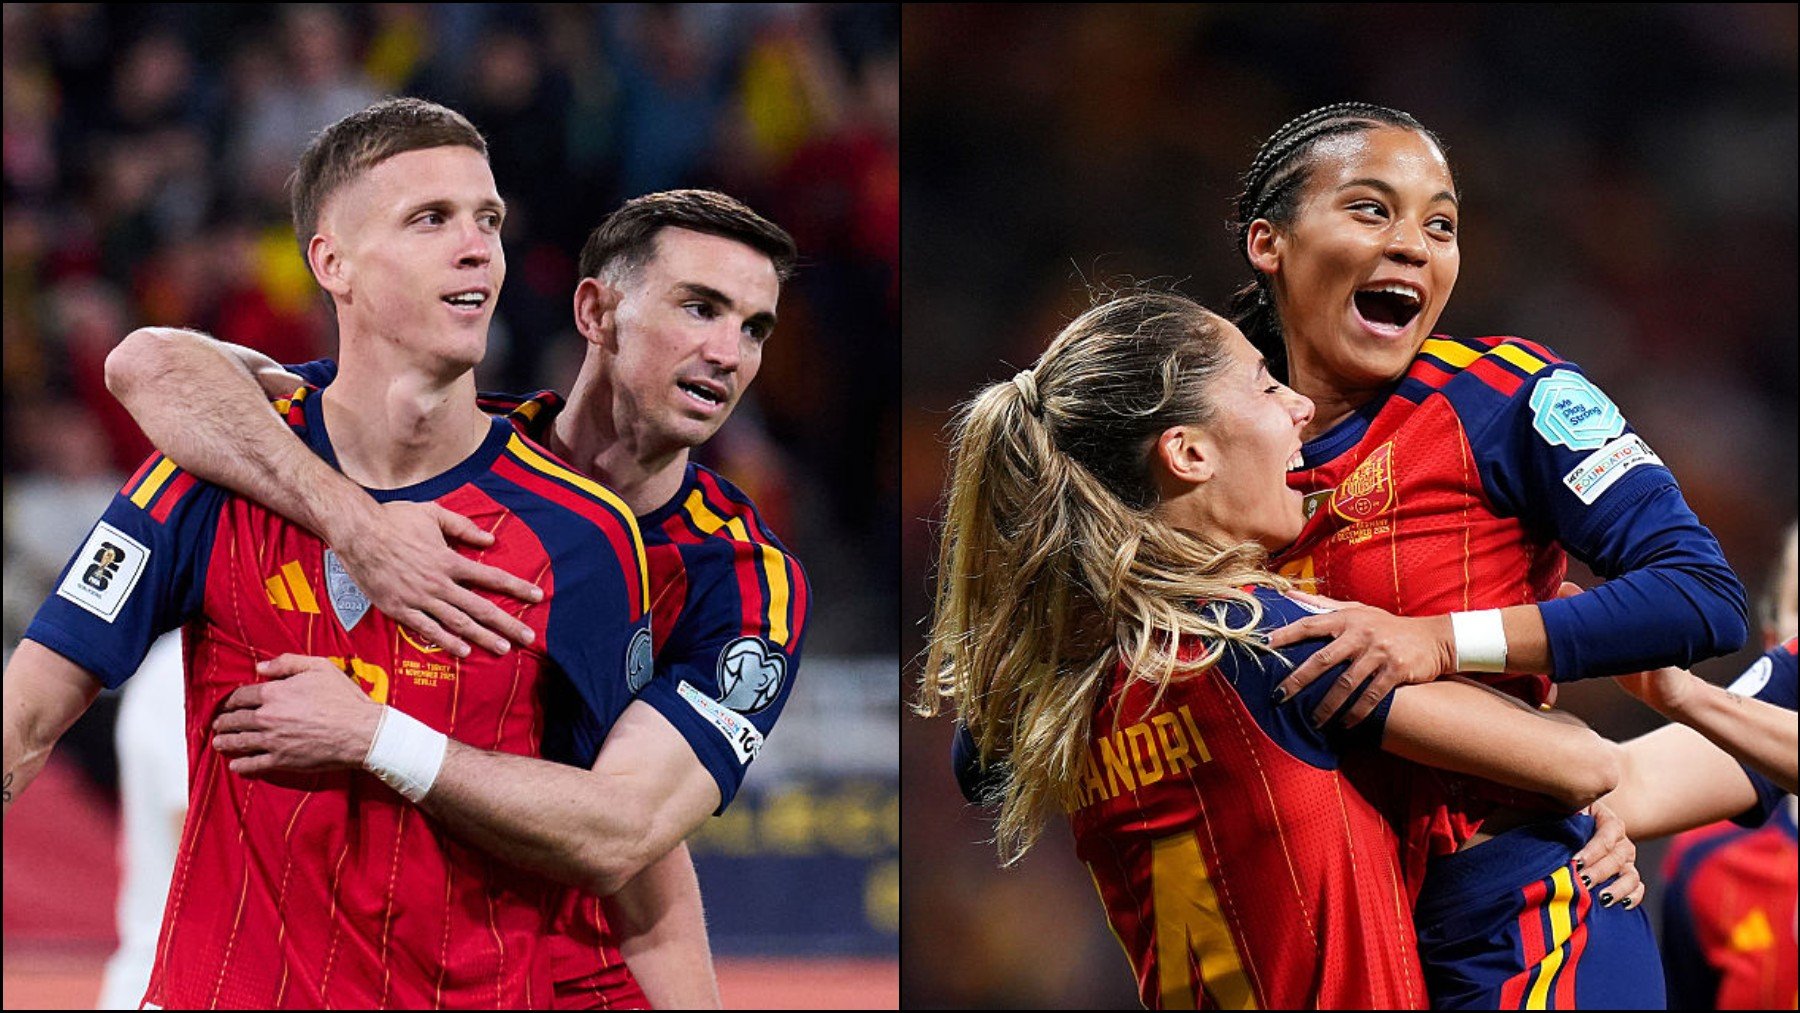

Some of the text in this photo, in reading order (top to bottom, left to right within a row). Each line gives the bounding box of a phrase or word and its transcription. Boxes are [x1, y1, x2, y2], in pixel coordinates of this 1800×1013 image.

[1562, 404, 1586, 418] Play
[1570, 406, 1602, 426] Strong
[1574, 445, 1640, 493] FOUNDATION
[338, 601, 363, 612] 2024
[405, 668, 439, 679] NOVEMBER
[413, 677, 438, 688] SEVILLE
